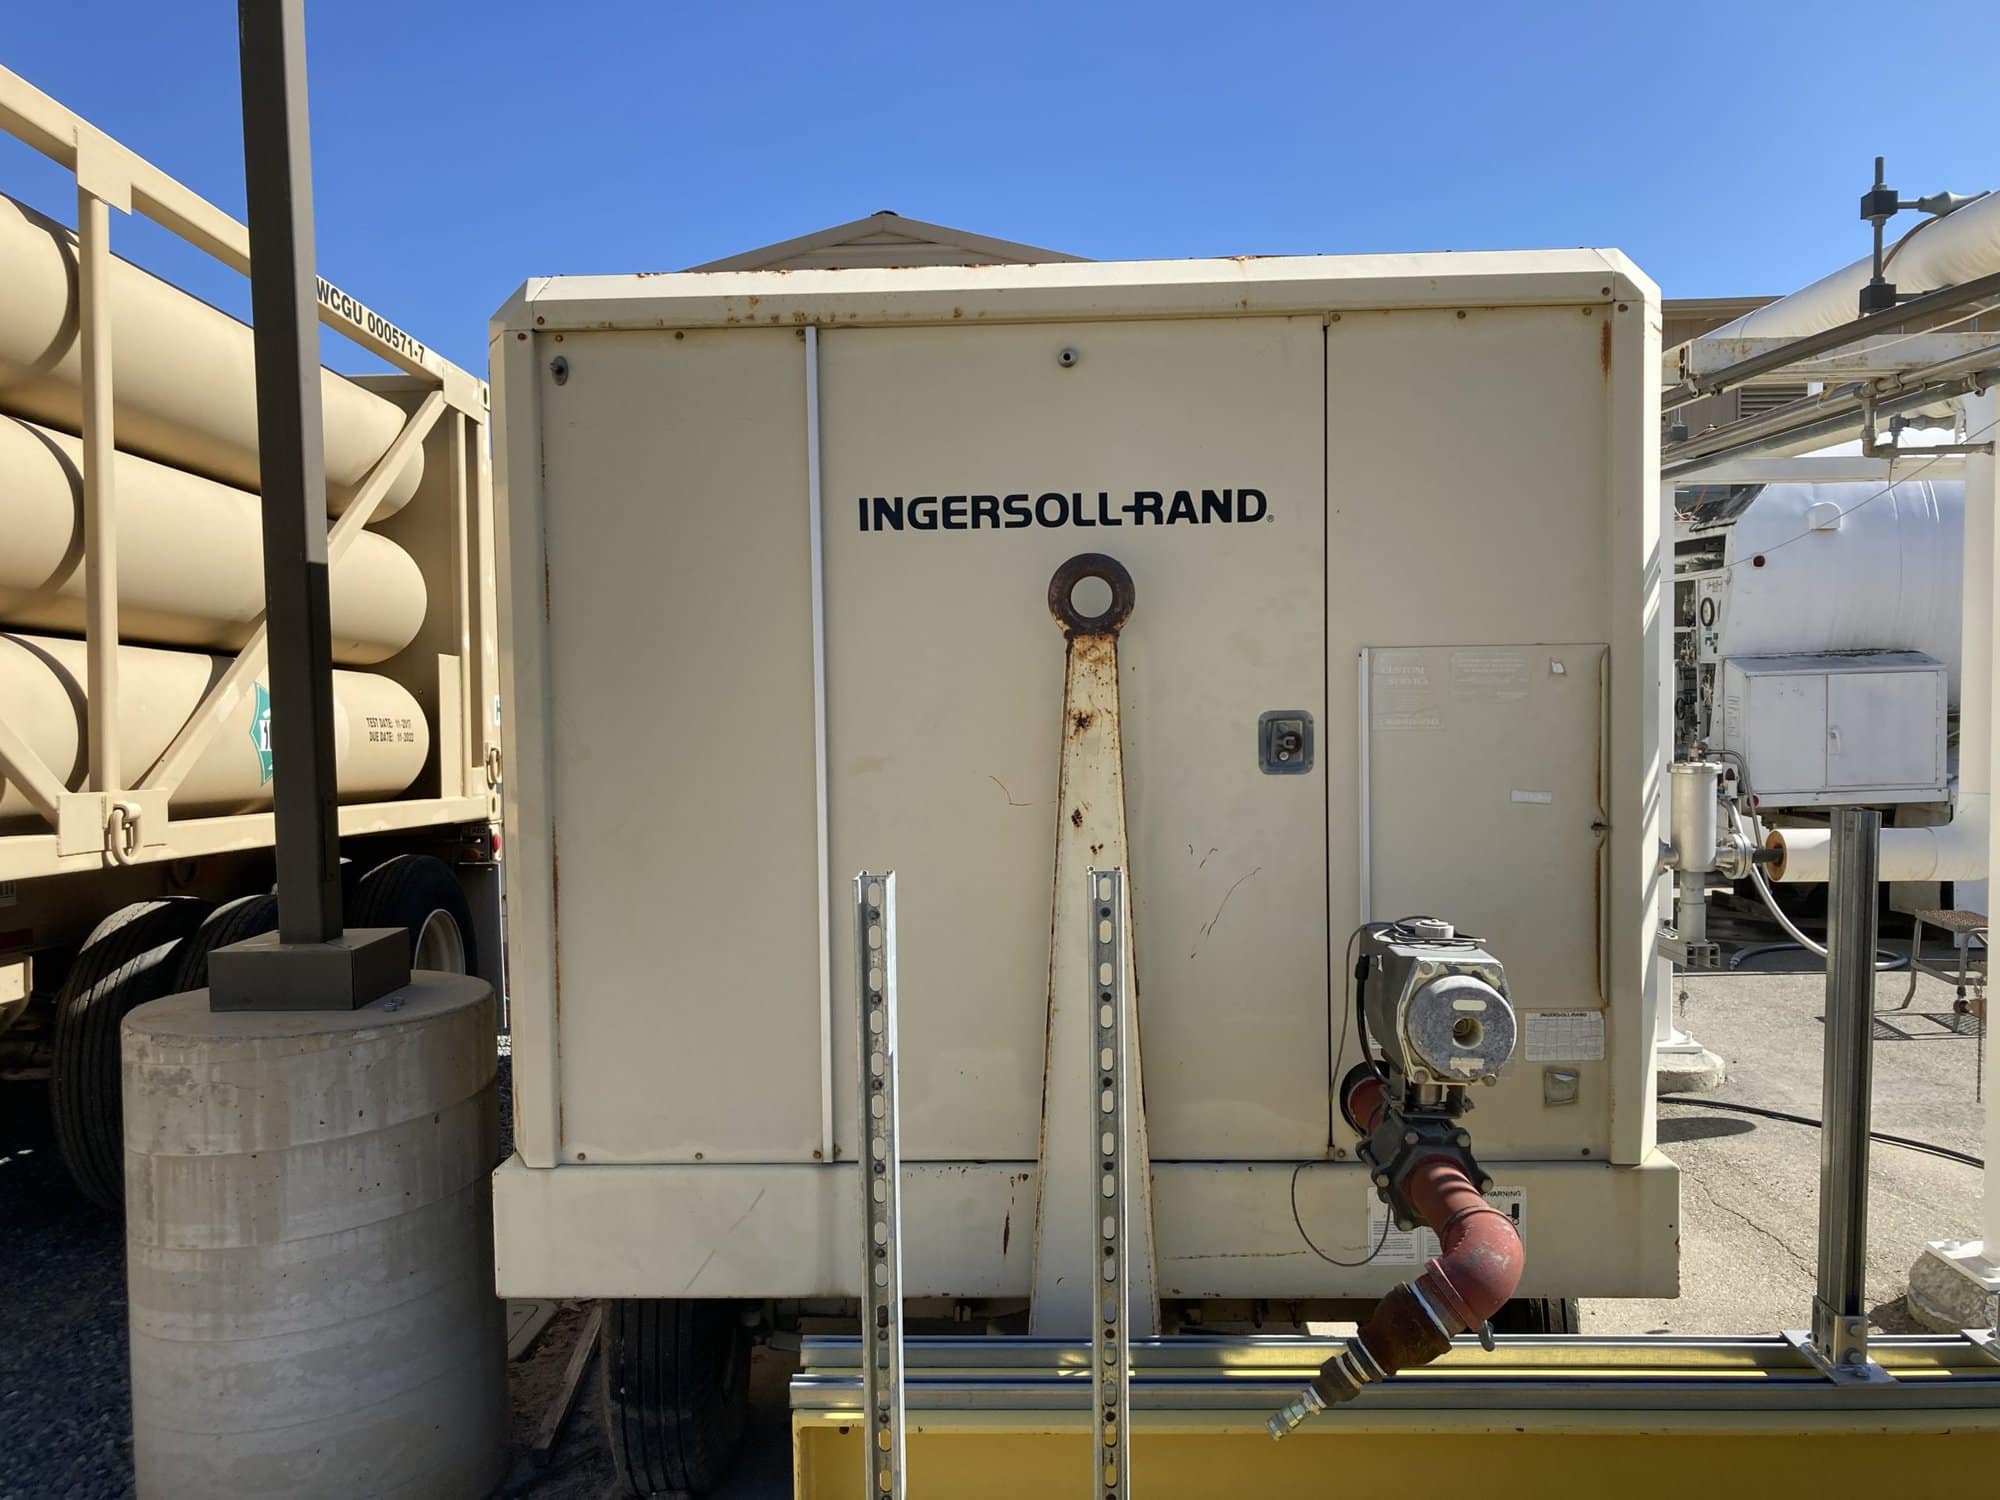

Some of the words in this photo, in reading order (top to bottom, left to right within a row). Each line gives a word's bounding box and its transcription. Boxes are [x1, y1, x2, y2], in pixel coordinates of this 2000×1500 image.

[316, 277, 363, 325] WCGU
[367, 312, 425, 364] 000571-7
[858, 488, 1268, 531] INGERSOLL-RAND
[366, 717, 379, 728] TEST
[369, 731, 379, 742] DUE
